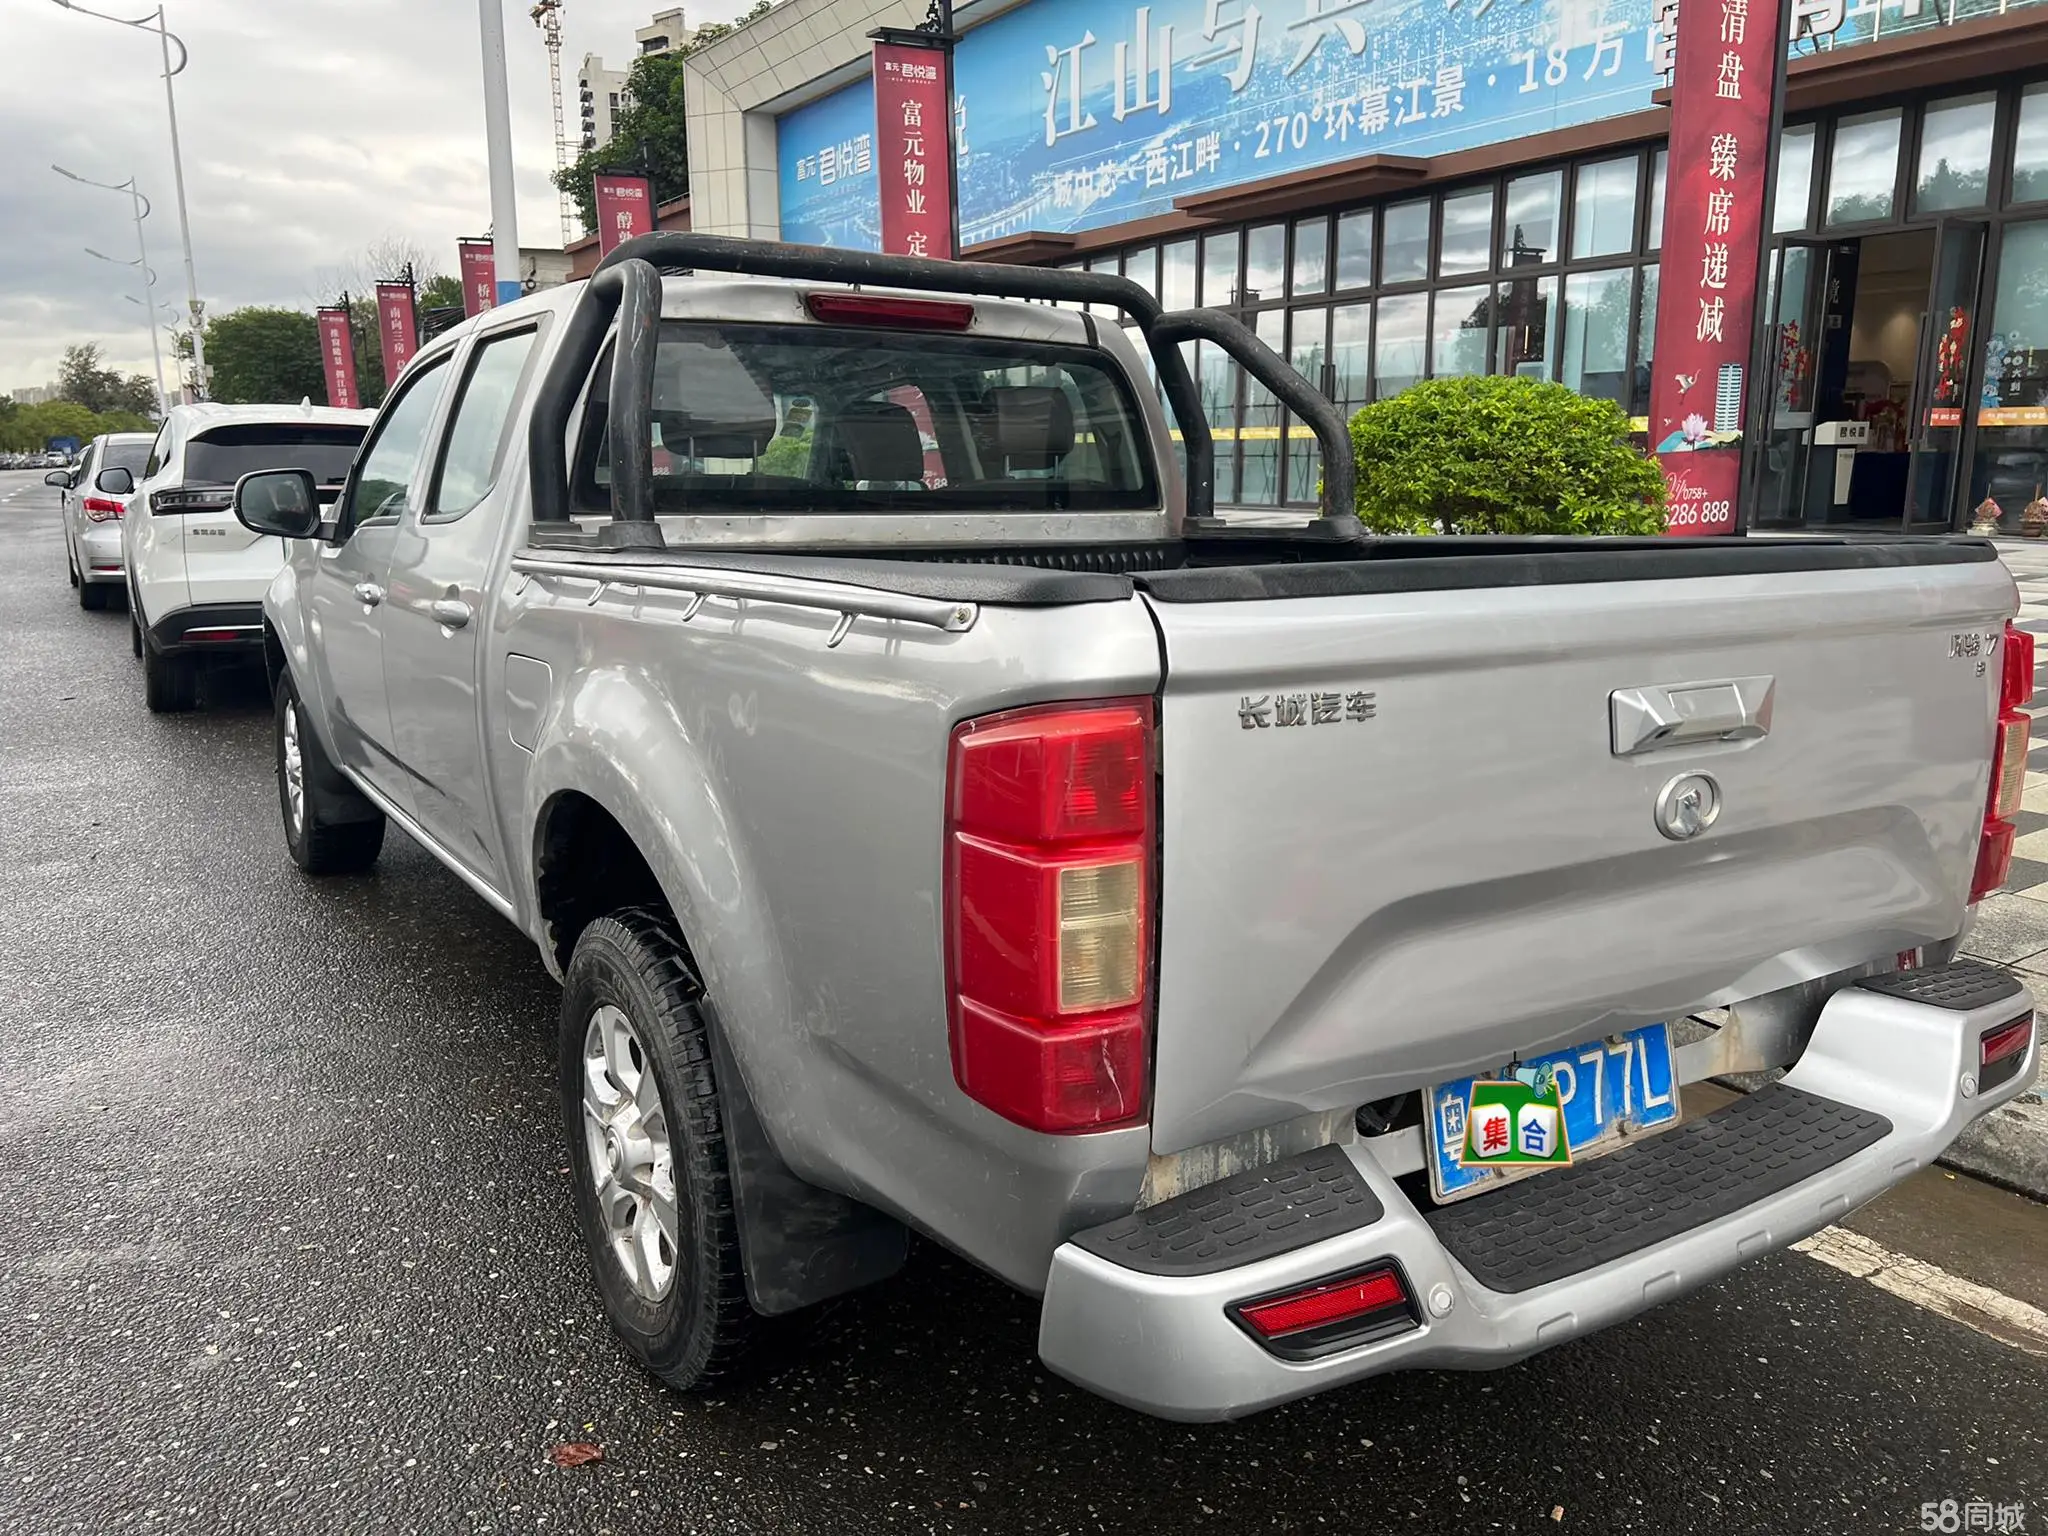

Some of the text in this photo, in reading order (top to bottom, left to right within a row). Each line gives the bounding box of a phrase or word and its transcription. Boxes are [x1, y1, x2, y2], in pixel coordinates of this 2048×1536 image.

[901, 99, 928, 215] 富元物业
[1696, 132, 1739, 344] 臻席递减
[1701, 500, 1729, 523] 888
[1238, 691, 1377, 730] 长城汽车
